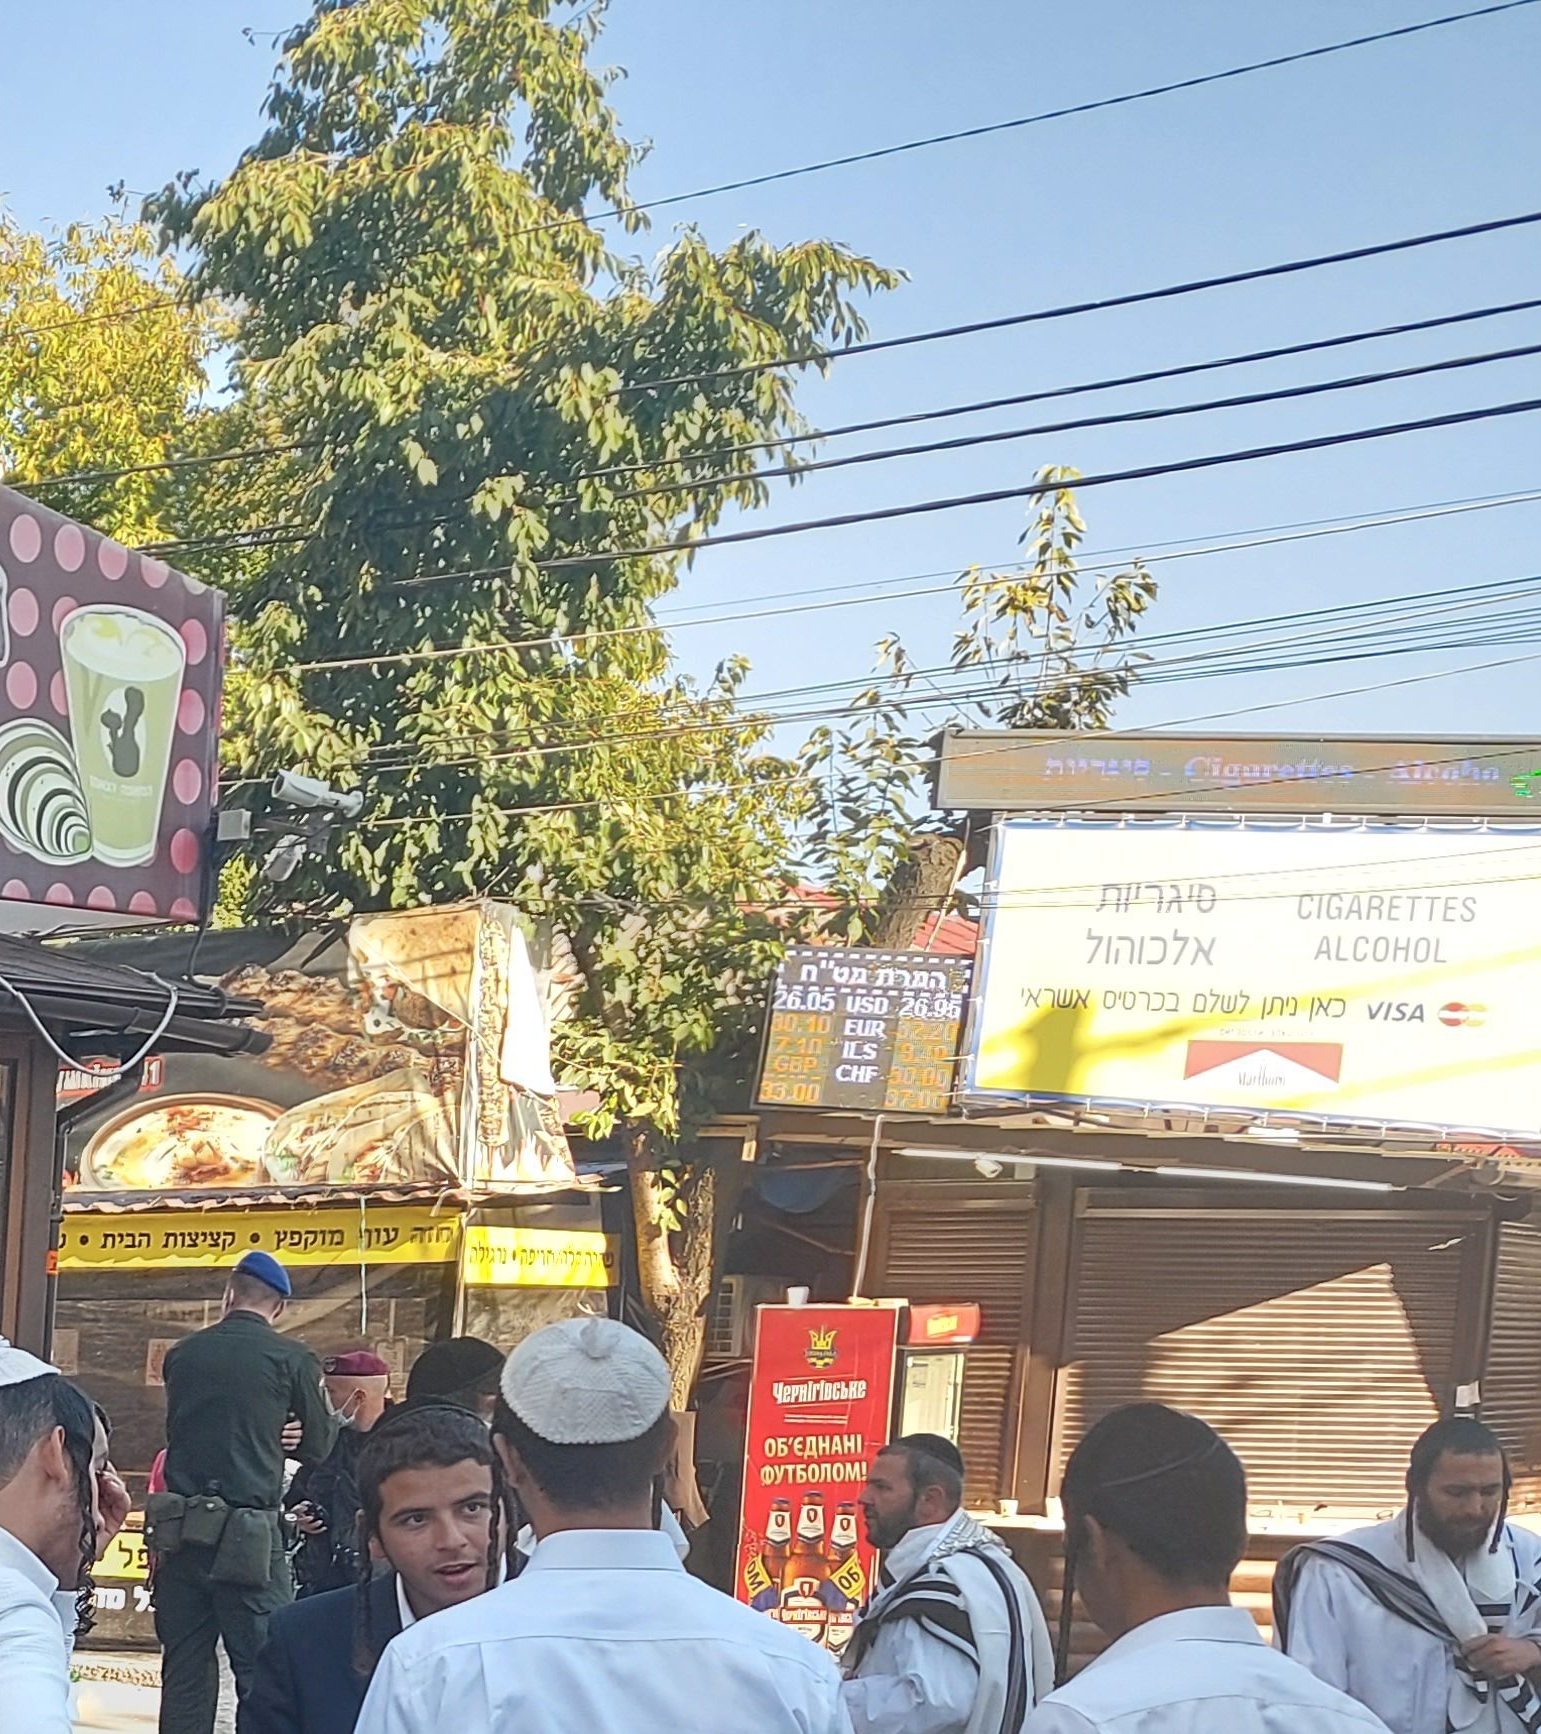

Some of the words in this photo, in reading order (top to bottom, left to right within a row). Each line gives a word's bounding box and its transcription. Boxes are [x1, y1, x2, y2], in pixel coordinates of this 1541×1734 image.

[1095, 883, 1217, 914] סיגריות
[1296, 893, 1477, 923] CIGARETTES
[1085, 929, 1217, 967] אלכוהול
[1314, 935, 1448, 964] ALCOHOL
[772, 991, 836, 1012] 26.05
[845, 997, 890, 1015] USD
[1020, 987, 1091, 1010] אשראי
[1103, 989, 1180, 1015] בכרטיס
[1192, 989, 1249, 1016] לשלם
[1259, 993, 1298, 1020] ניתן
[1309, 996, 1347, 1023] כאן
[1367, 1002, 1426, 1023] VISA
[843, 1018, 886, 1037] EUR
[842, 1041, 878, 1060] ILS
[835, 1064, 879, 1083] CHF
[100, 1231, 152, 1249] הבית
[162, 1230, 236, 1251] קציצות
[274, 1228, 346, 1250] מוקפץ
[764, 1434, 863, 1460] ОБ'ЄДНАНІ
[760, 1461, 868, 1486] ФУТБОЛОМ!
